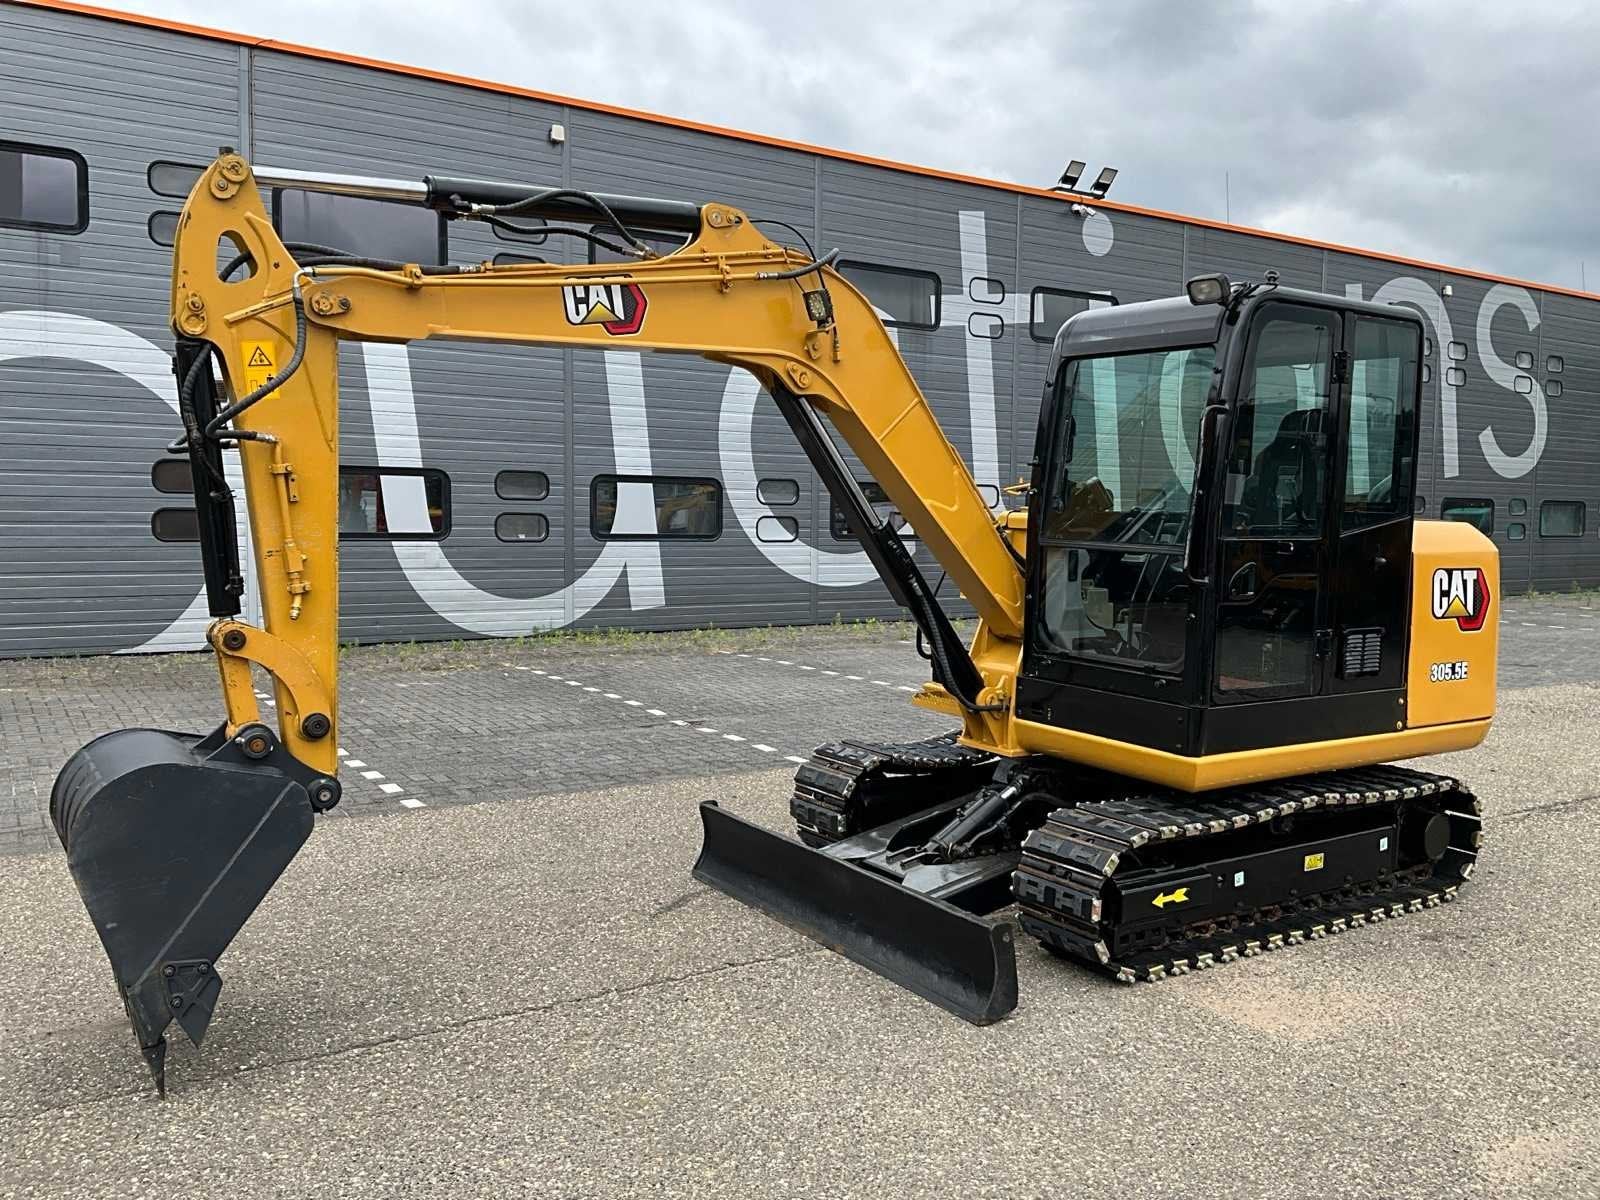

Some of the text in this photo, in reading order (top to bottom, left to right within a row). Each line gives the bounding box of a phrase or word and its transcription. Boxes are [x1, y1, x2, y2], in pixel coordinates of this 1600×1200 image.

[561, 274, 627, 324] CAT
[1432, 568, 1478, 618] CAT
[1430, 660, 1470, 682] 305.5E
